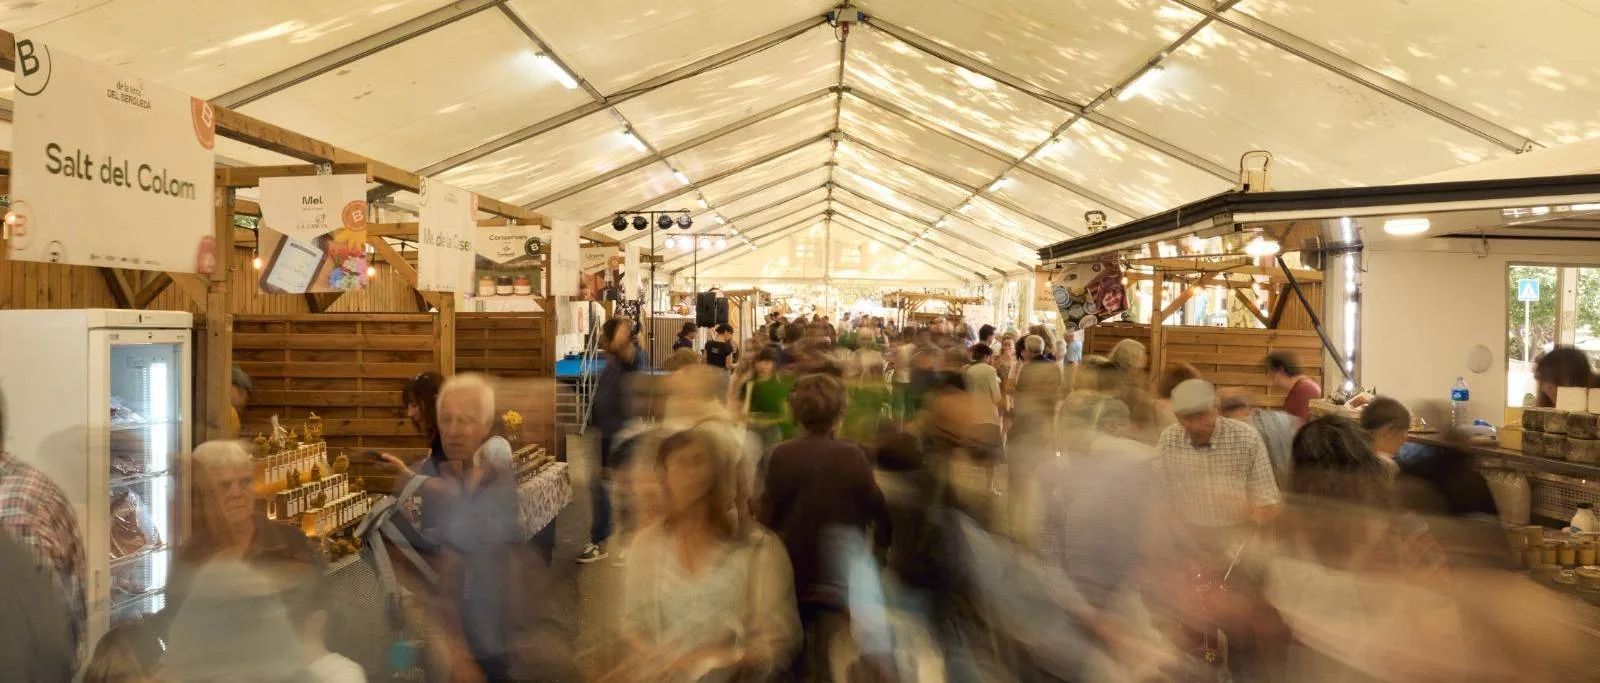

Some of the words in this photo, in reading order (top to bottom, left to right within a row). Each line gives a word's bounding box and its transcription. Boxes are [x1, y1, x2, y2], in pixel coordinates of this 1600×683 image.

[17, 38, 40, 77] B
[201, 102, 213, 128] B
[46, 142, 93, 181] Salt
[100, 156, 132, 188] del
[137, 164, 196, 200] Colom
[302, 195, 324, 205] Mel
[351, 209, 364, 223] B
[530, 242, 539, 251] B
